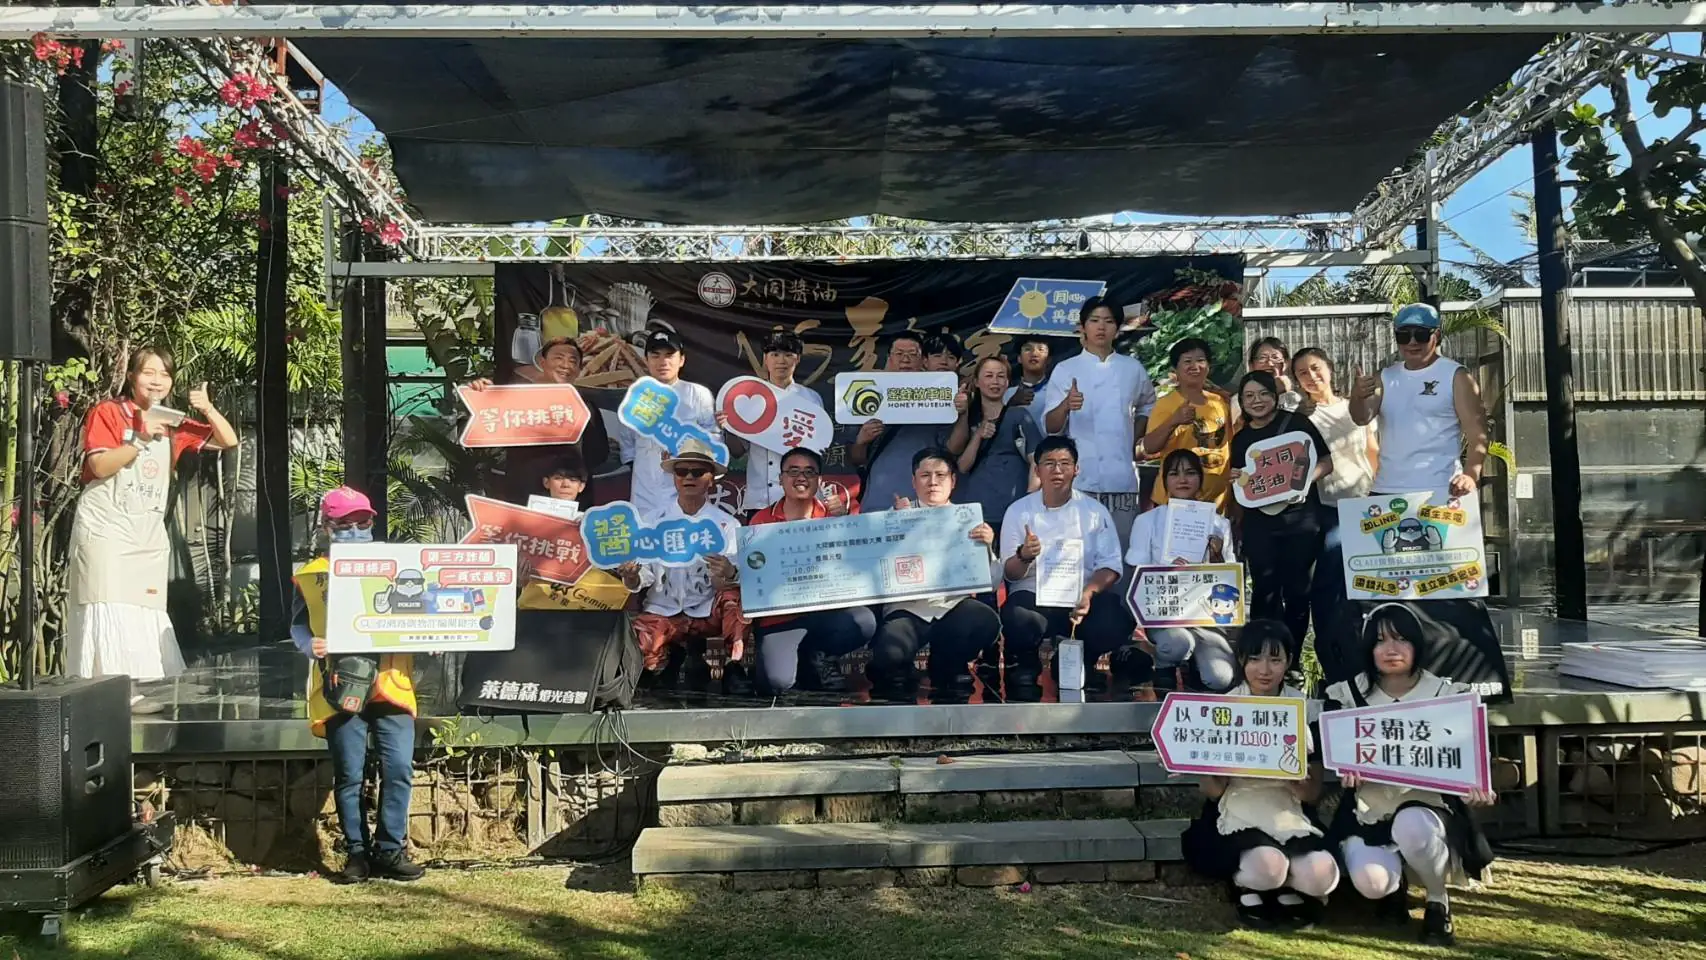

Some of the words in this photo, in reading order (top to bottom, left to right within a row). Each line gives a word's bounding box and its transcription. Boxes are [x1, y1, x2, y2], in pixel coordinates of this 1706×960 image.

[740, 274, 837, 304] 大同醬油
[887, 387, 952, 401] 蜜蜂故事館
[479, 404, 575, 433] 等你挑戰
[783, 408, 816, 448] 愛
[1262, 448, 1294, 468] 大同
[1249, 473, 1286, 495] 醬油
[479, 523, 581, 564] 等你挑戰
[593, 513, 717, 556] 醬心匯味
[1175, 705, 1289, 727] 以『報』制暴
[1172, 728, 1278, 747] 報案請打110!
[1354, 717, 1453, 742] 反霸凌、
[1355, 743, 1462, 770] 反性剝削
